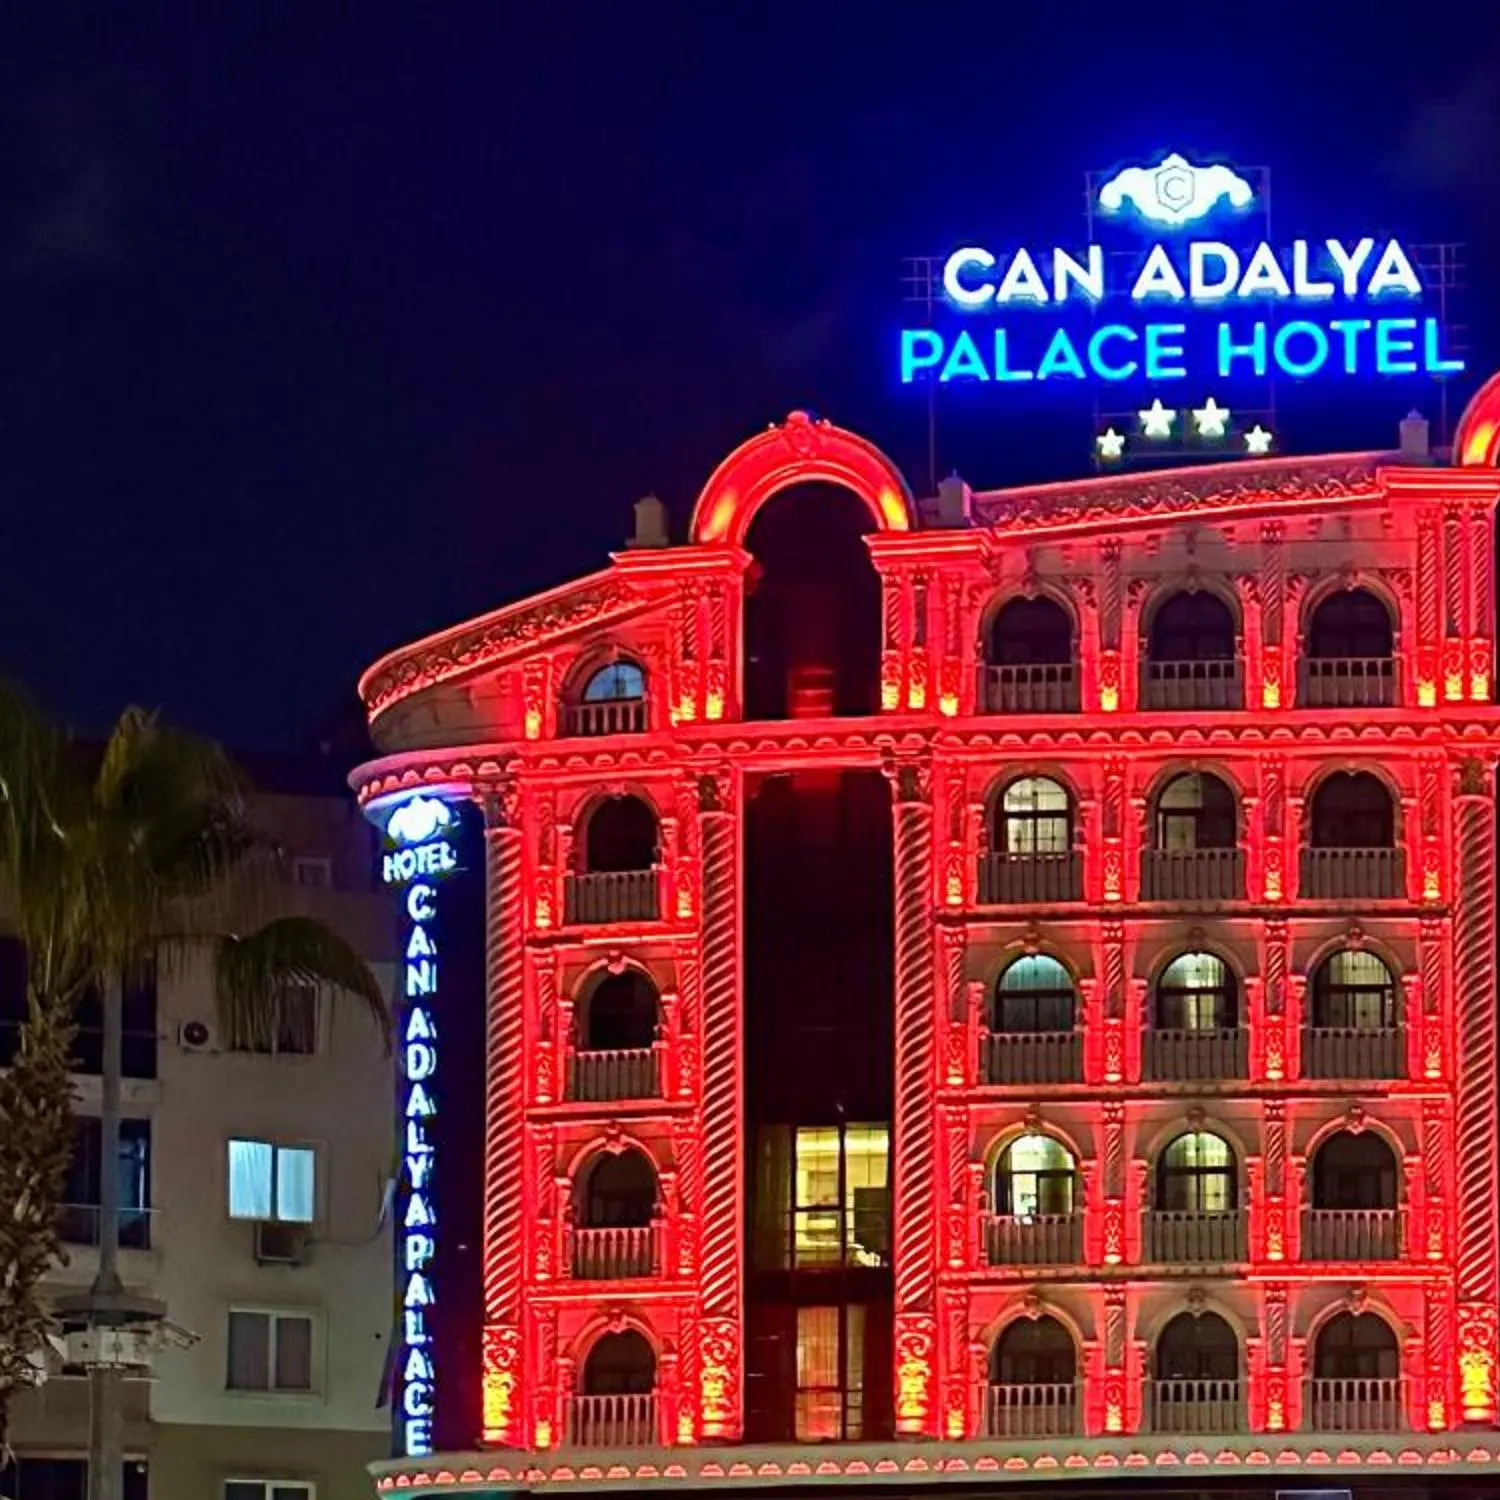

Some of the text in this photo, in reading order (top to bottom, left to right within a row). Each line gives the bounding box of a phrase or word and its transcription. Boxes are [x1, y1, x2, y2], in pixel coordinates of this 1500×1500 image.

[1164, 176, 1185, 201] C
[943, 238, 1422, 304] CAN ADALYA
[901, 318, 1465, 383] PALACE HOTEL
[383, 841, 457, 883] HOTEL
[404, 883, 437, 1457] CAN ADALYA PALACE
